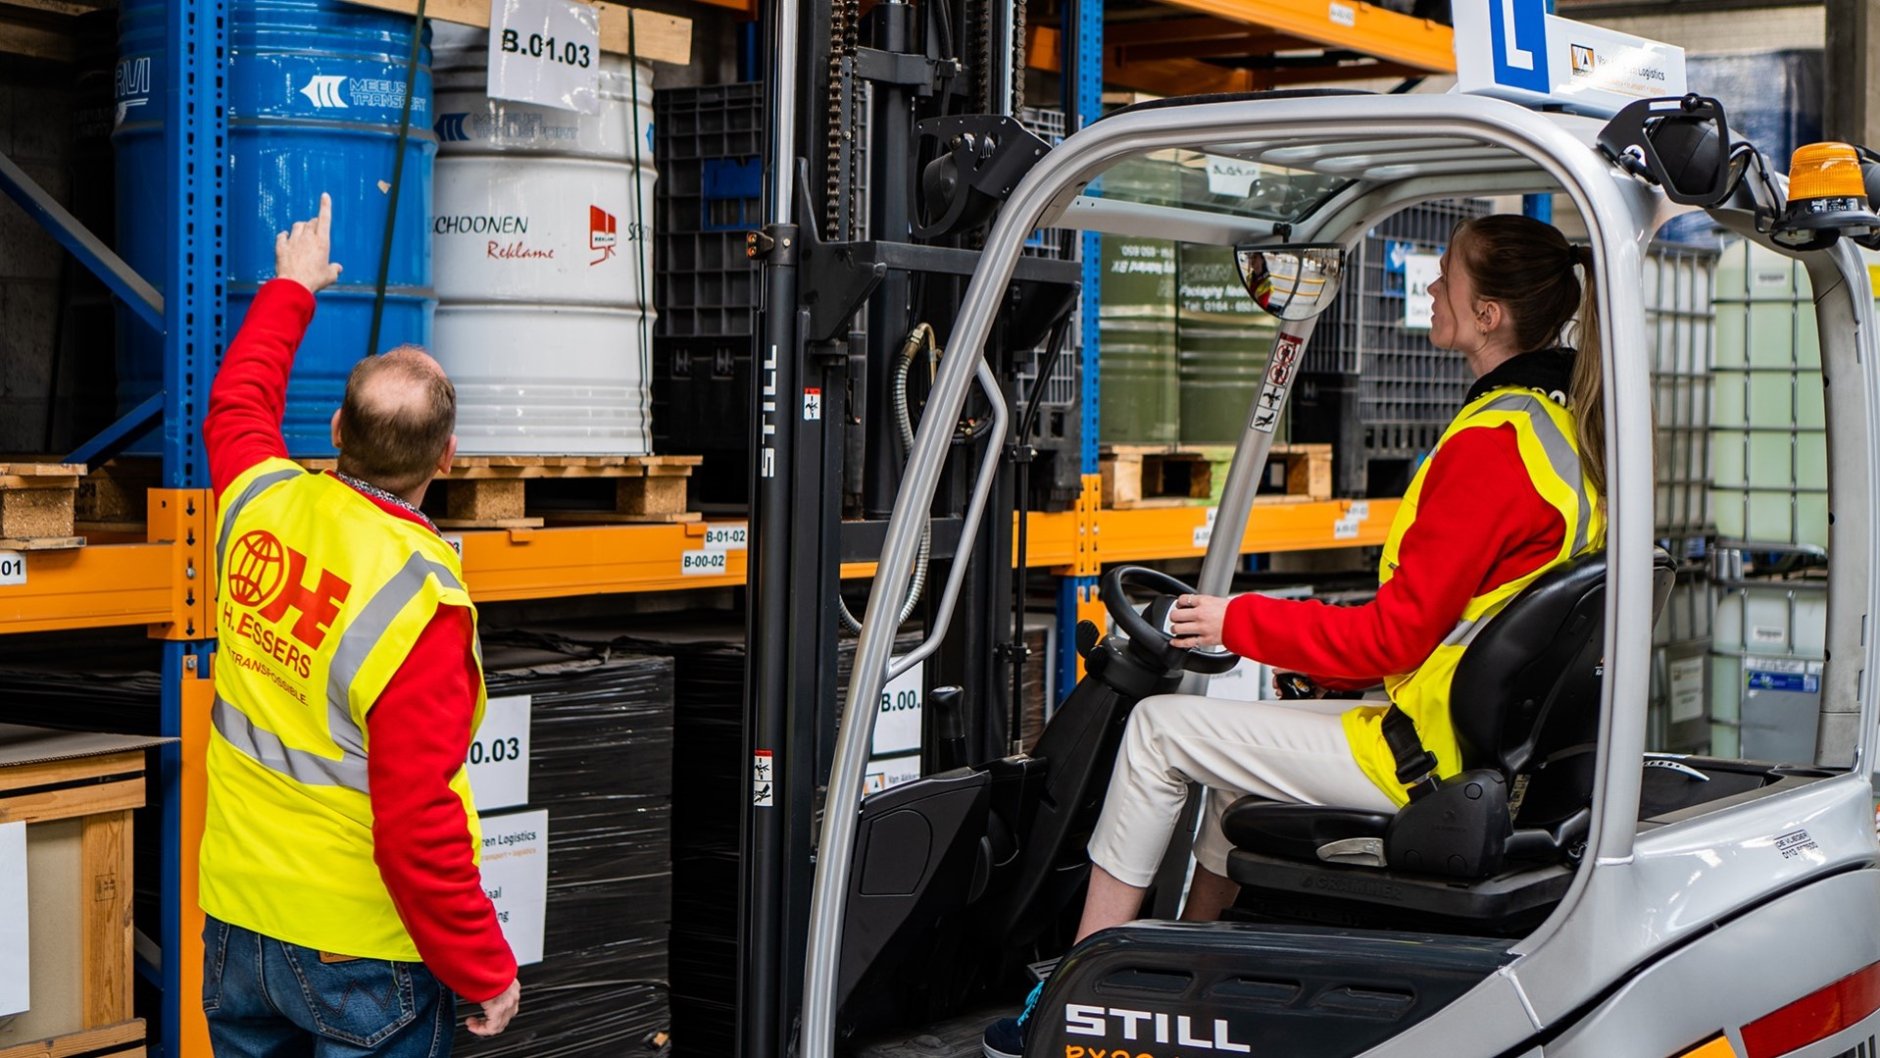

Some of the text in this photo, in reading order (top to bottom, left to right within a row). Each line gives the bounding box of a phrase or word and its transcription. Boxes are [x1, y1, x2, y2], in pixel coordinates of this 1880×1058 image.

[502, 29, 590, 68] B.01.03
[1501, 0, 1534, 70] L
[349, 78, 407, 96] MEEUS
[486, 240, 555, 260] Reklame
[761, 344, 777, 478] STILL
[706, 530, 746, 543] B-01-02
[683, 554, 725, 568] B-00-02
[236, 612, 312, 679] ESSERS
[498, 832, 537, 847] Logistics
[1065, 1003, 1251, 1053] STILL
